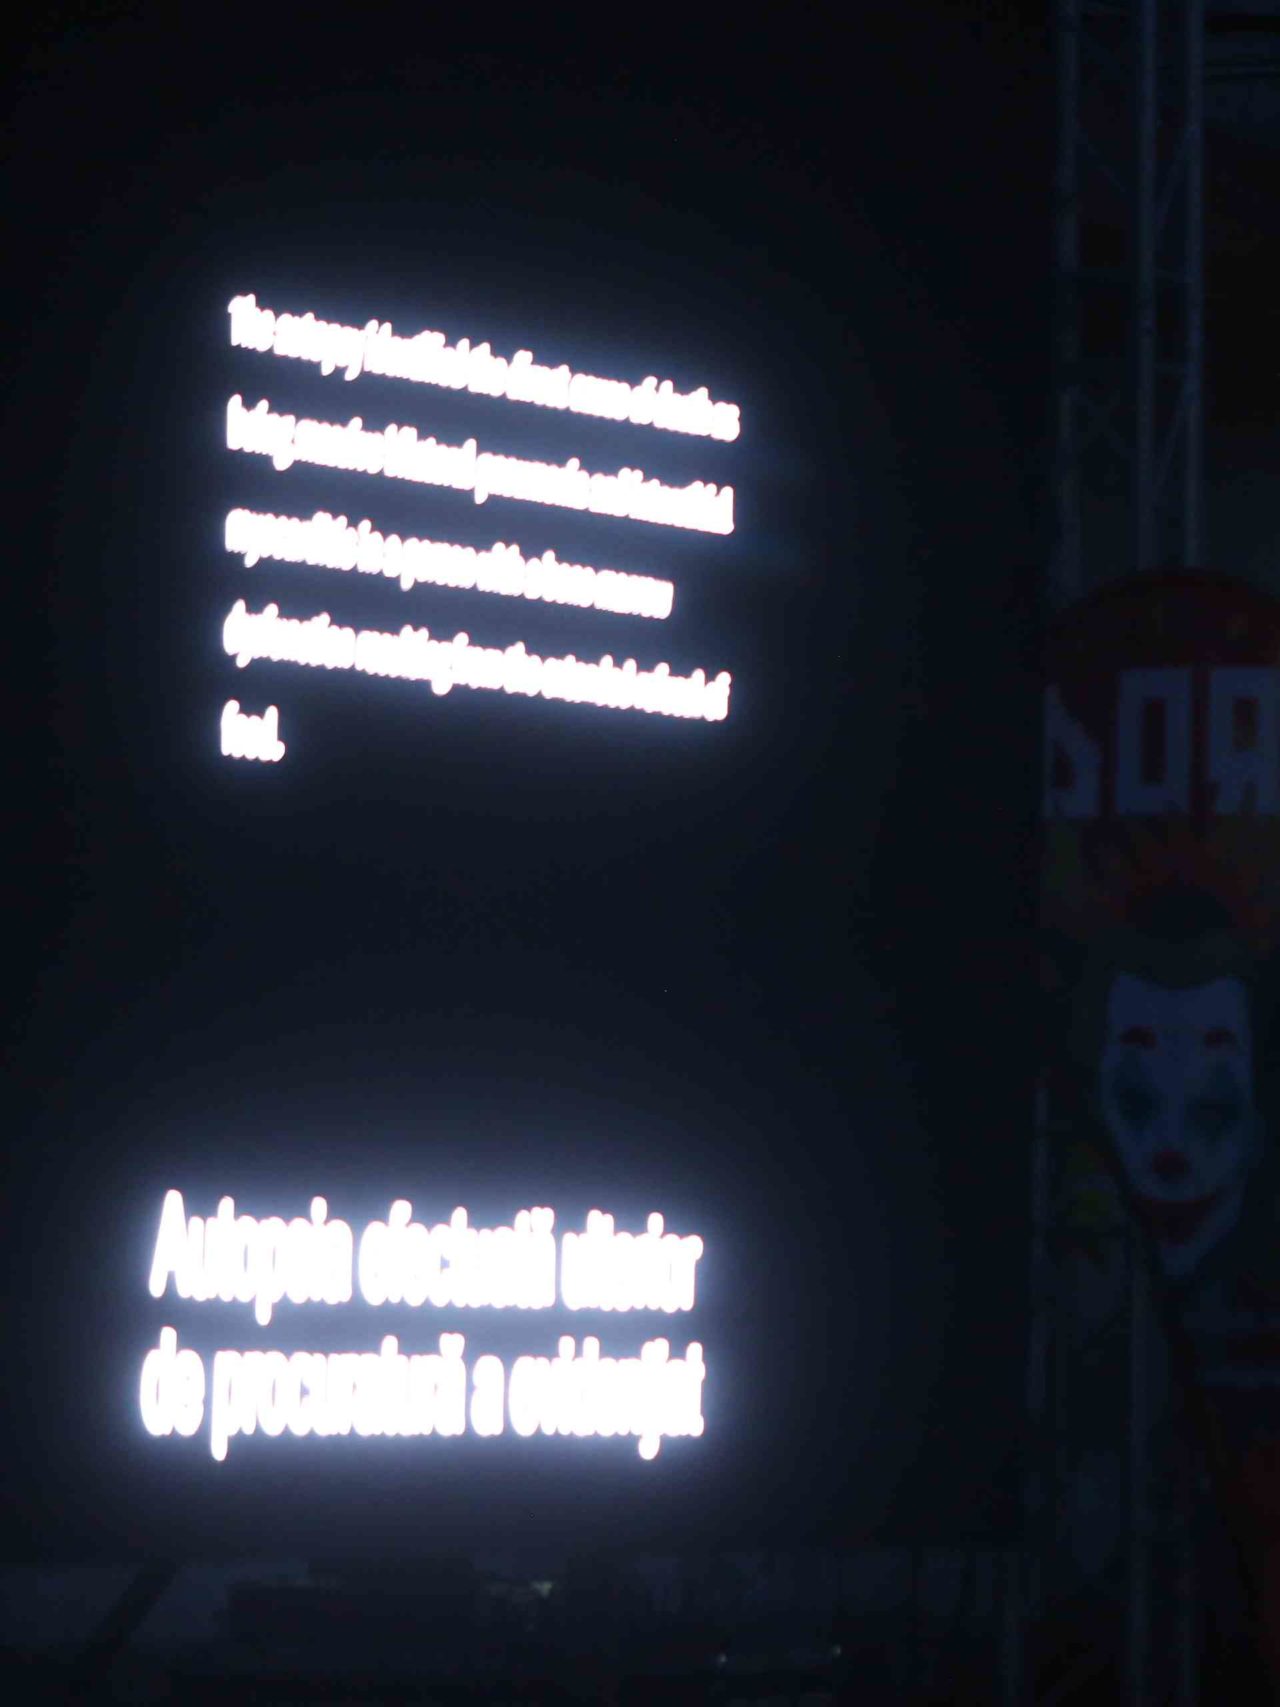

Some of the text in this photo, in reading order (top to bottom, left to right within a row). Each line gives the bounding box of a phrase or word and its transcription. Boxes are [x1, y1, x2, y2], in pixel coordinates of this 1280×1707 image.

[150, 1190, 352, 1325] Autopsia
[140, 1327, 205, 1436] de
[471, 1355, 504, 1436] a
